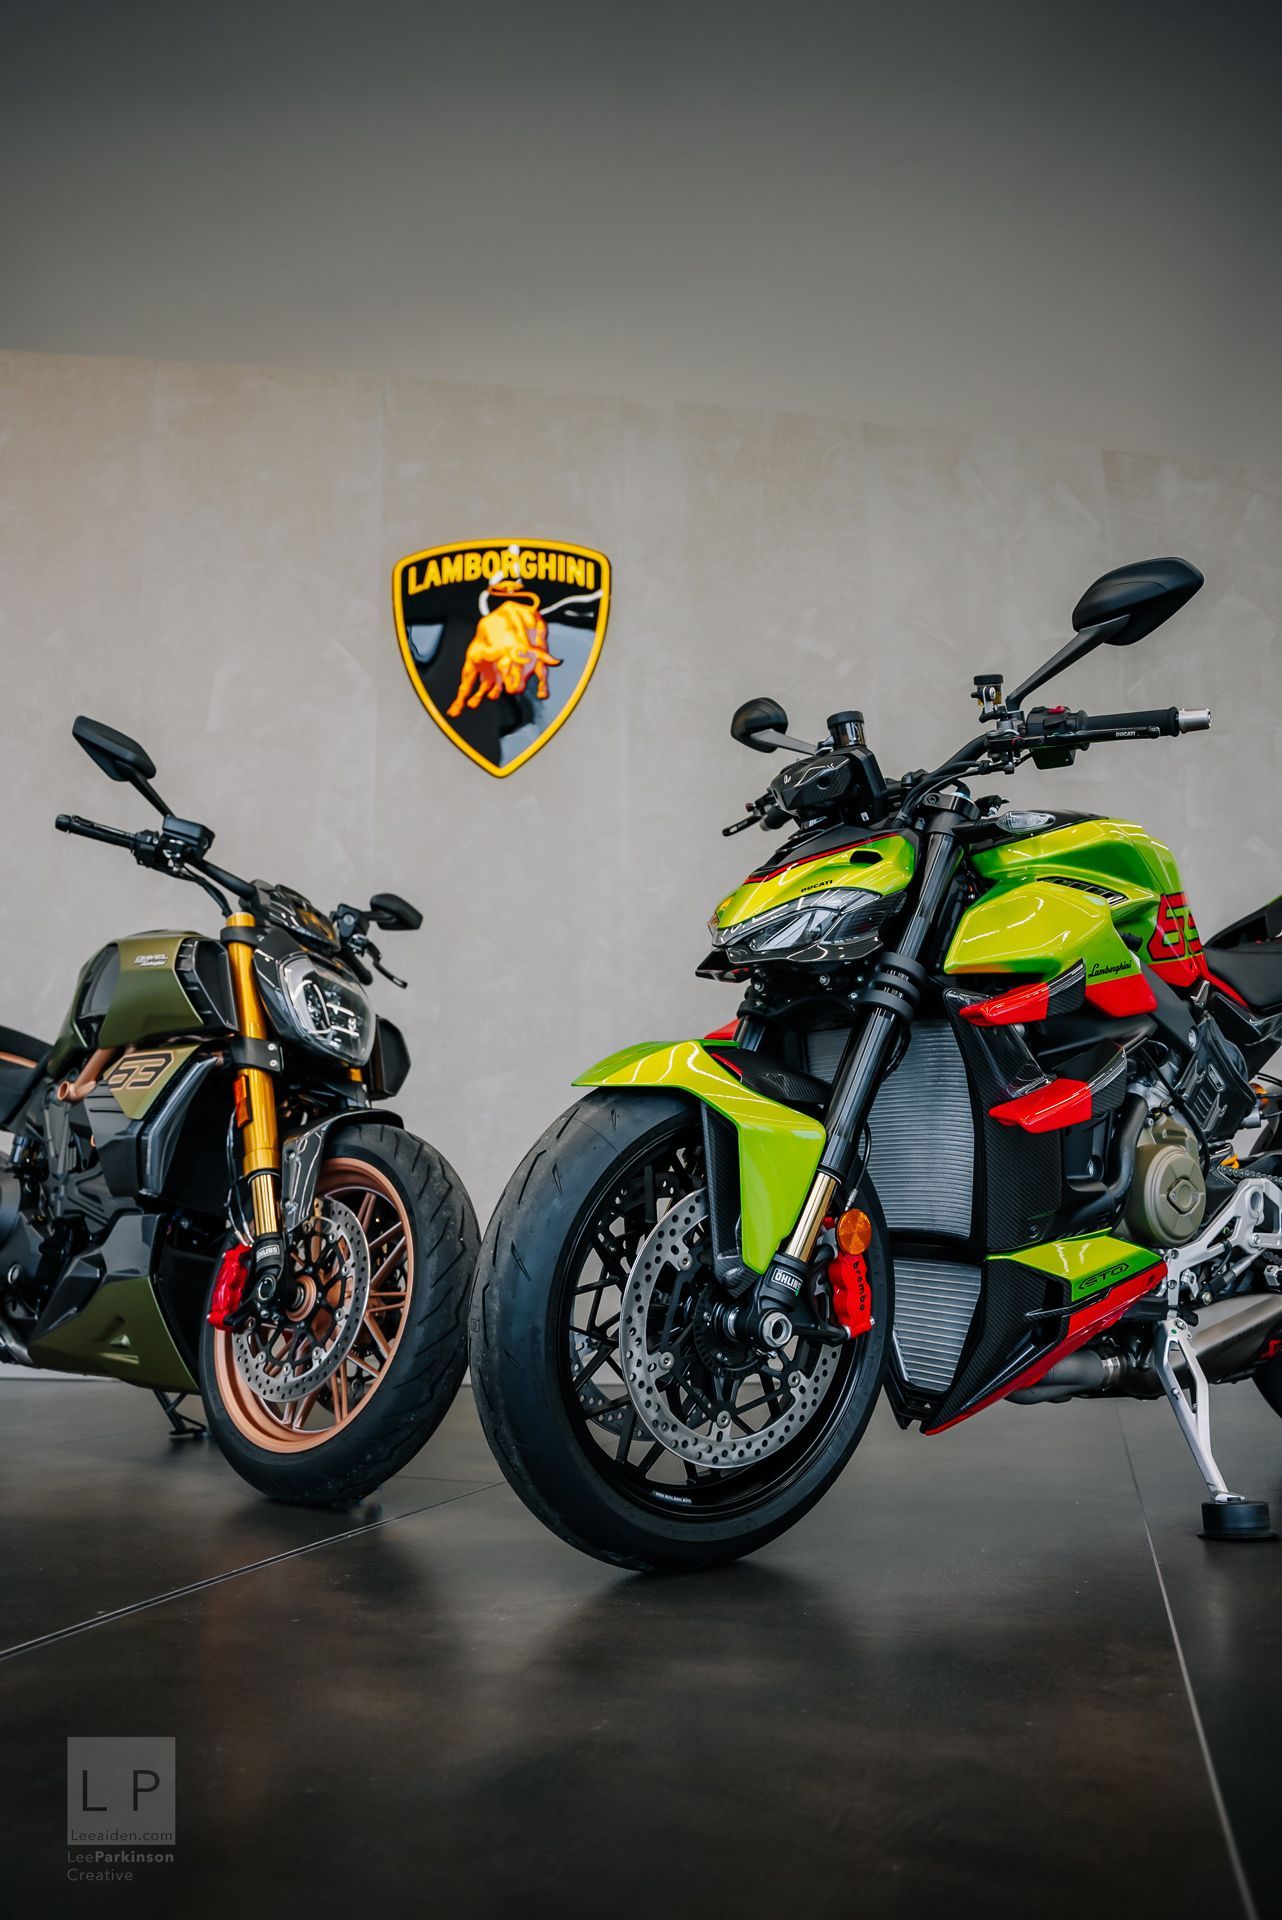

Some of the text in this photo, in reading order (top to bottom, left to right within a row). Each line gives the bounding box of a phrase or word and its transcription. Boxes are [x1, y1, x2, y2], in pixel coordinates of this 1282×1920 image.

[408, 550, 595, 595] LAMBORGHINI
[800, 879, 834, 893] DUCATI
[1087, 959, 1132, 978] Lamborghini
[107, 1051, 173, 1091] 63
[853, 1261, 867, 1312] brembo
